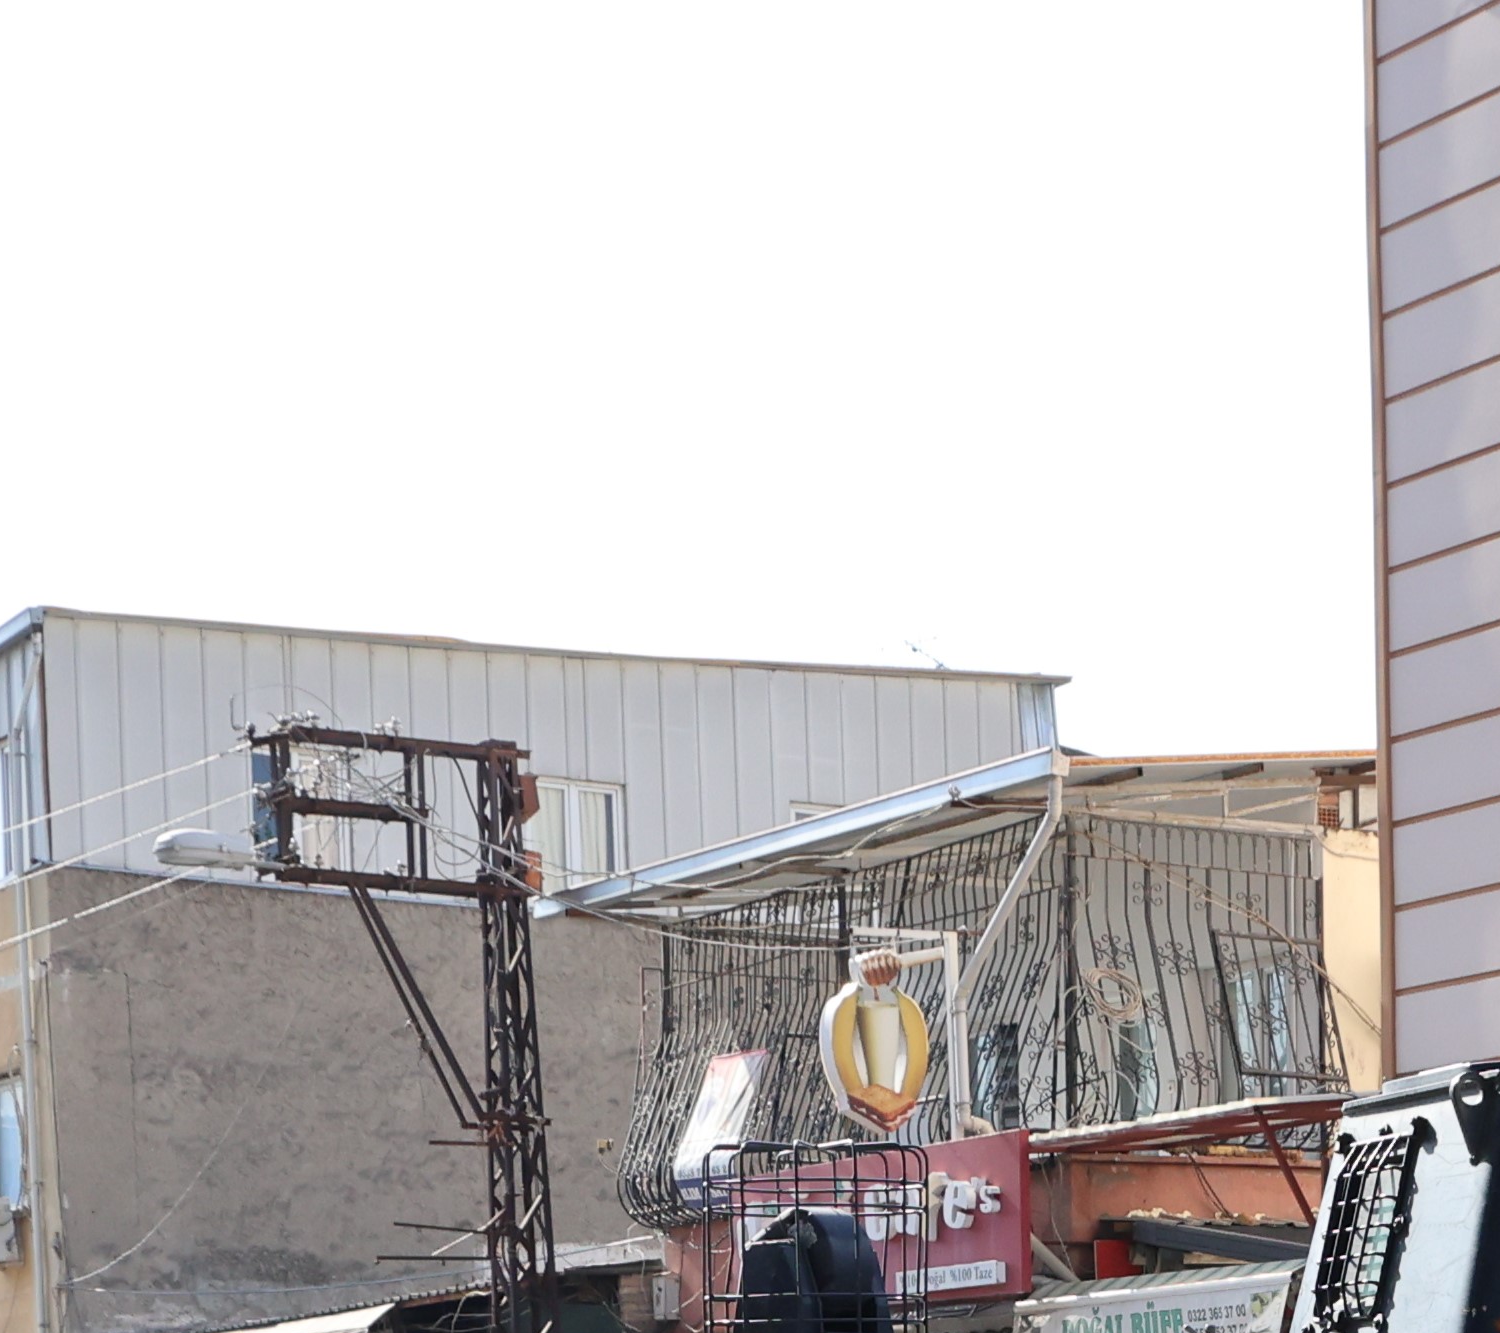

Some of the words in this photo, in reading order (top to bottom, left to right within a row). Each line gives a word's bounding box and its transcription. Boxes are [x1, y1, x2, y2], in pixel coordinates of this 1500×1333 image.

[927, 1270, 947, 1289] oğal
[949, 1268, 972, 1283] %100
[973, 1265, 993, 1280] Taze
[1187, 1308, 1207, 1323] 0322
[1208, 1307, 1223, 1321] 365
[1224, 1306, 1234, 1318] 37
[1236, 1304, 1247, 1317] 00
